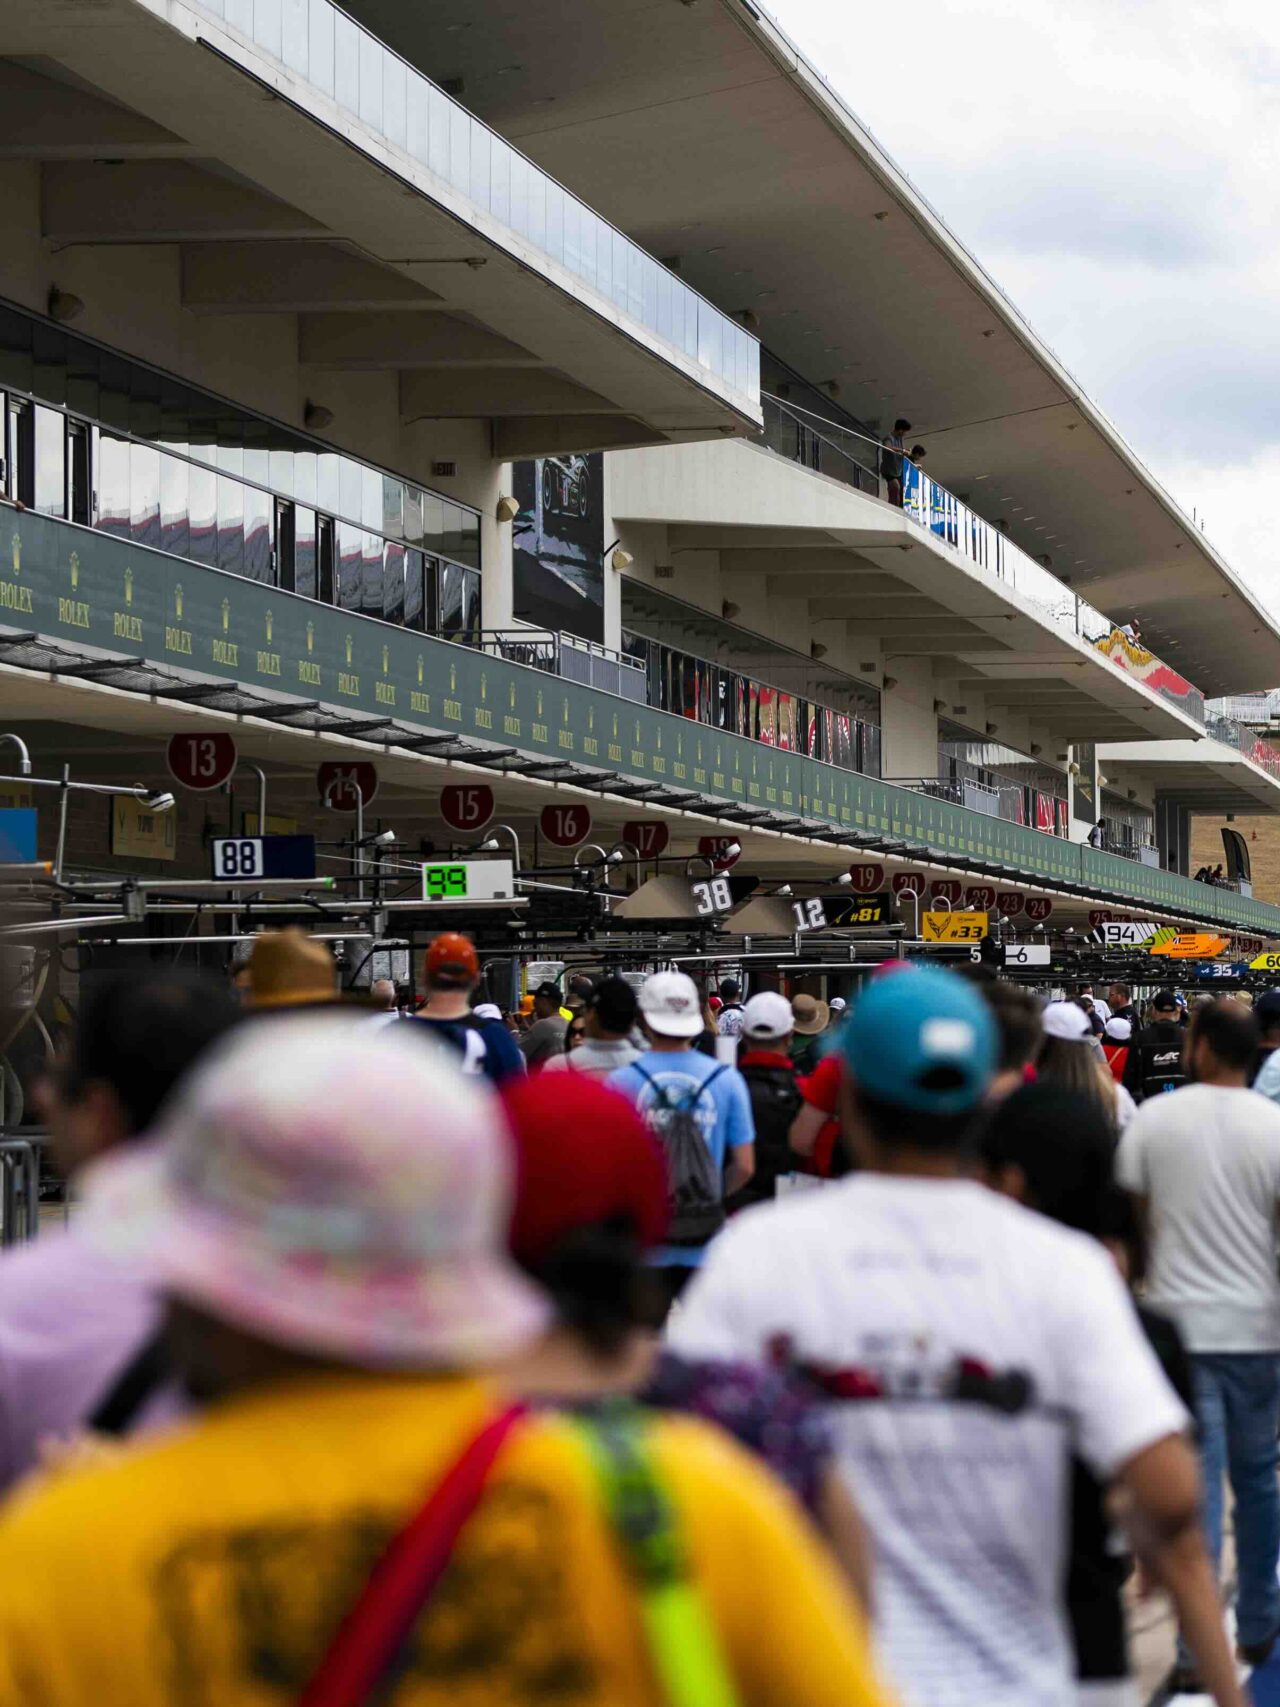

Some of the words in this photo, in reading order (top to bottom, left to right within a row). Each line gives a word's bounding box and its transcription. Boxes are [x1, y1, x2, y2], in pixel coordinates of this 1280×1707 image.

[0, 581, 33, 613] ROLEX
[59, 598, 90, 628] ROLEX
[114, 612, 143, 642] ROLEX
[166, 627, 192, 655] ROLEX
[213, 640, 238, 667] ROLEX
[257, 651, 281, 676] ROLEX
[299, 660, 321, 685] ROLEX
[338, 673, 360, 696] ROLEX
[375, 681, 396, 705] ROLEX
[411, 691, 430, 713] ROLEX
[188, 740, 217, 777] 13
[334, 767, 358, 800] 14
[456, 791, 479, 821] 15
[555, 810, 577, 837] 16
[637, 825, 657, 849] 17
[222, 842, 256, 875] 88
[427, 868, 467, 893] 99
[858, 868, 875, 888] 19
[900, 876, 918, 895] 20
[692, 878, 733, 915] 38
[1003, 895, 1018, 911] 23
[1031, 901, 1046, 916] 24
[792, 897, 827, 932] 12
[850, 907, 881, 922] #81
[1094, 912, 1108, 926] 25
[951, 926, 983, 938] #33
[1107, 926, 1135, 943] 94
[970, 947, 982, 964] 5
[1212, 964, 1232, 977] 35
